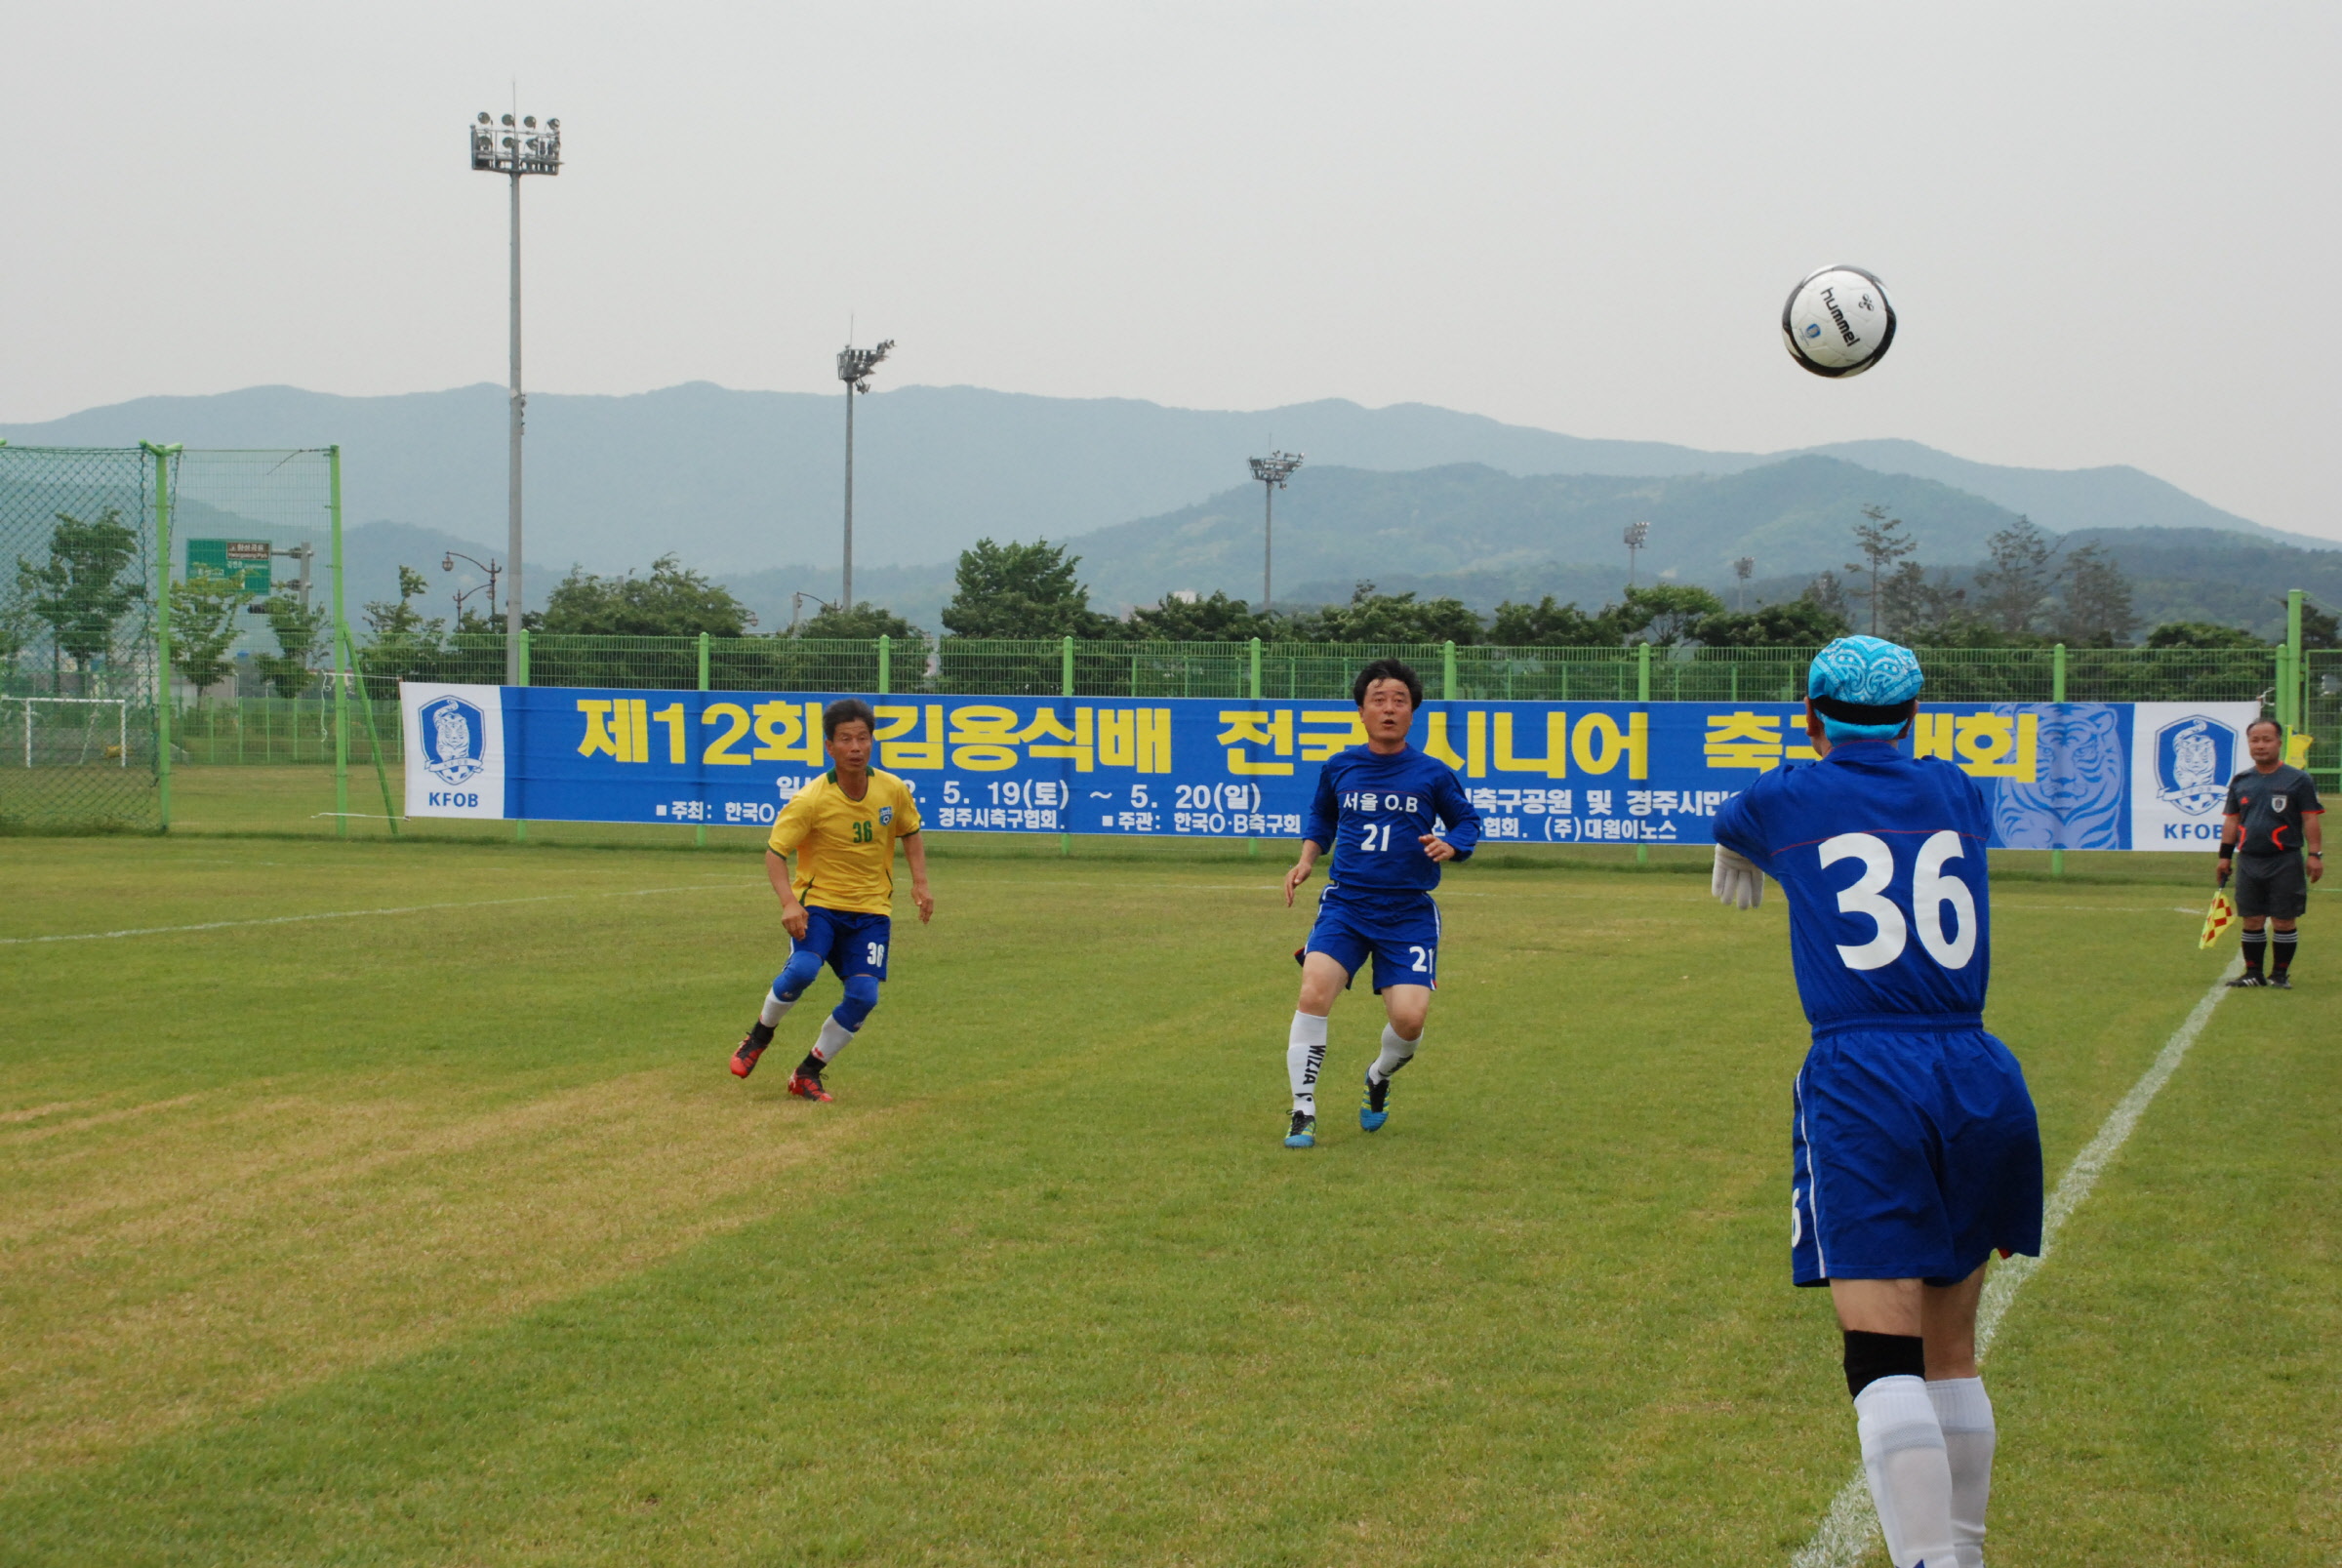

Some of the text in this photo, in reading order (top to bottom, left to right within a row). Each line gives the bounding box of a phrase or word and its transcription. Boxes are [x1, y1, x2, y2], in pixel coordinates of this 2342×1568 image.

[1820, 287, 1861, 347] hummel
[577, 699, 825, 767] 제12회
[873, 704, 1172, 773] 김용식배
[1216, 709, 1369, 776] 전국
[1423, 710, 1648, 780] 시니어
[428, 791, 479, 808] KFOB
[943, 781, 970, 804] 5.
[988, 779, 1070, 810] 19(토)
[1130, 784, 1158, 809] 5.
[1175, 783, 1262, 813] 20(일)
[1587, 790, 1612, 816] 및
[1343, 792, 1418, 813] 서울 O.B
[671, 800, 712, 821] 주최:
[939, 808, 1066, 829] 경주시축구협회.
[1118, 811, 1161, 832] 주관:
[852, 821, 873, 844] 36
[1360, 824, 1391, 852] 21
[1545, 816, 1677, 842] (주)대원이노스
[1818, 830, 1977, 970] 36
[868, 942, 885, 967] 36
[1409, 946, 1433, 975] 21
